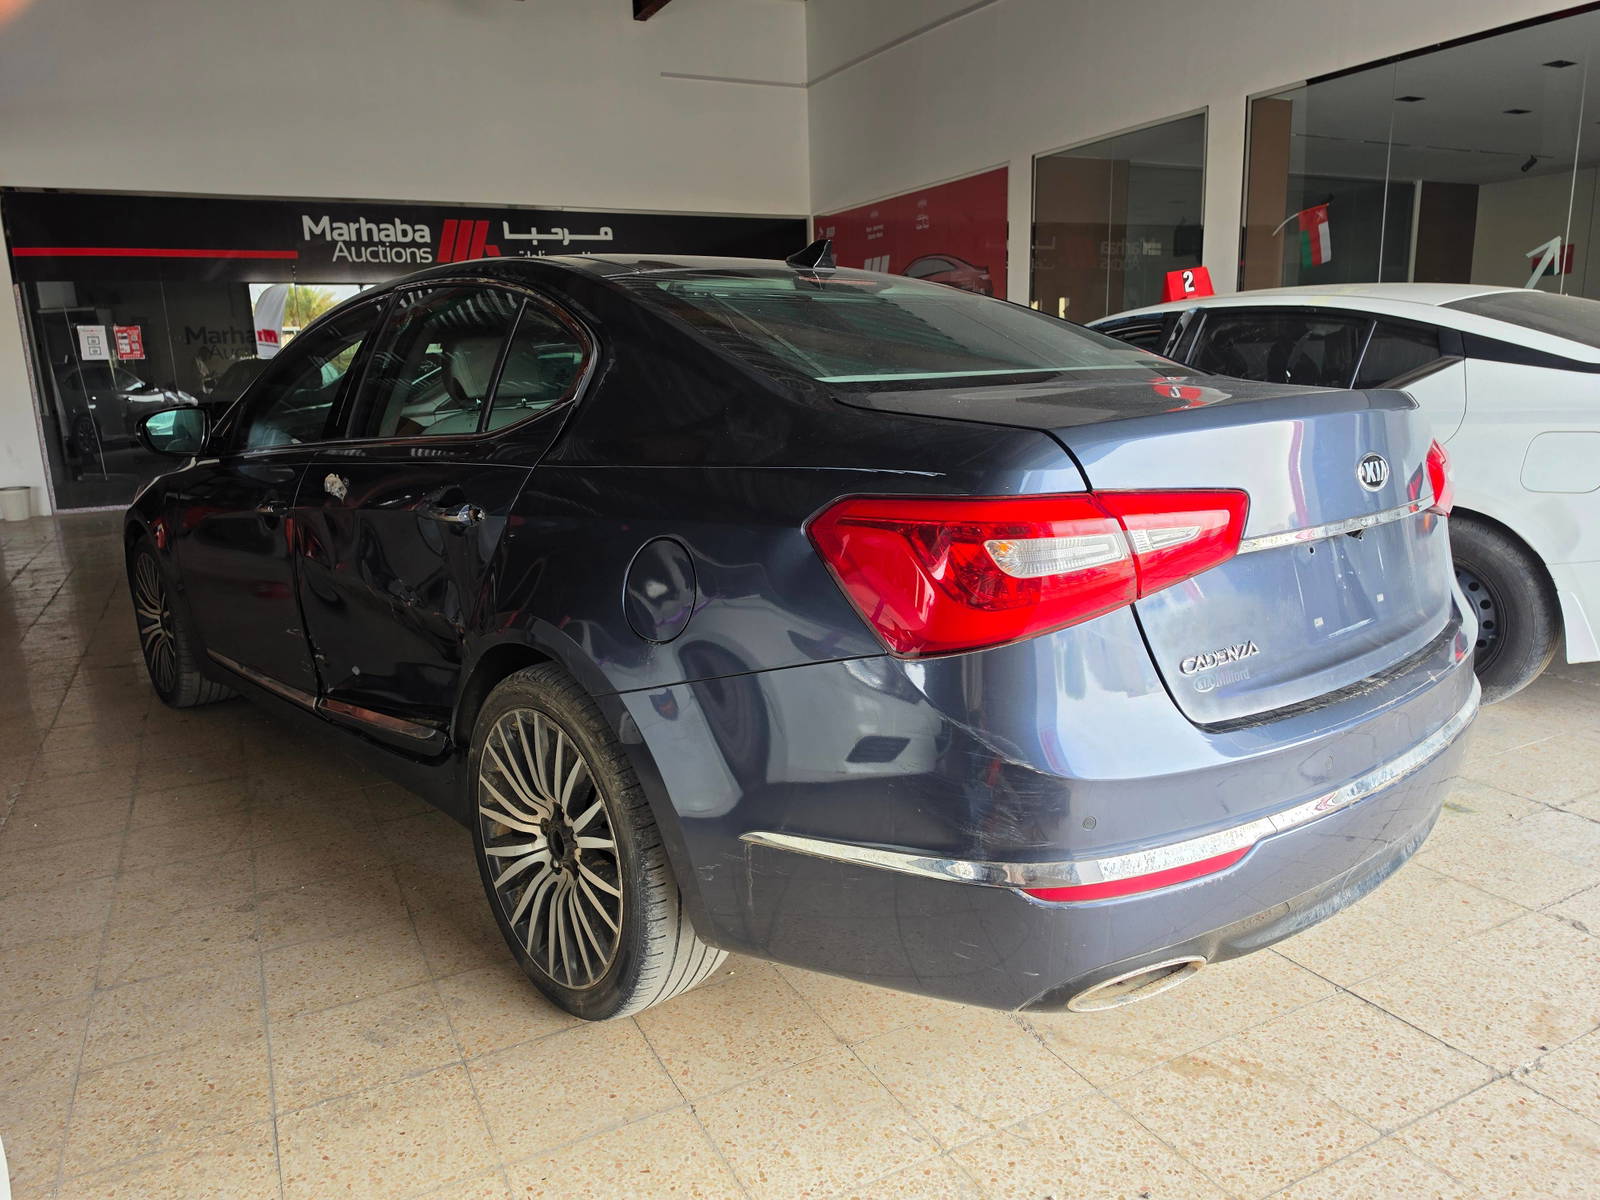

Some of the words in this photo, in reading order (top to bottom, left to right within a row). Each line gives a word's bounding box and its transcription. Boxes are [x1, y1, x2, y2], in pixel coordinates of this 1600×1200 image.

[302, 215, 431, 243] Marhaba
[502, 220, 613, 246] مرحبا
[332, 241, 433, 264] Auctions
[1182, 270, 1195, 293] 2
[1179, 640, 1260, 676] CADENZA
